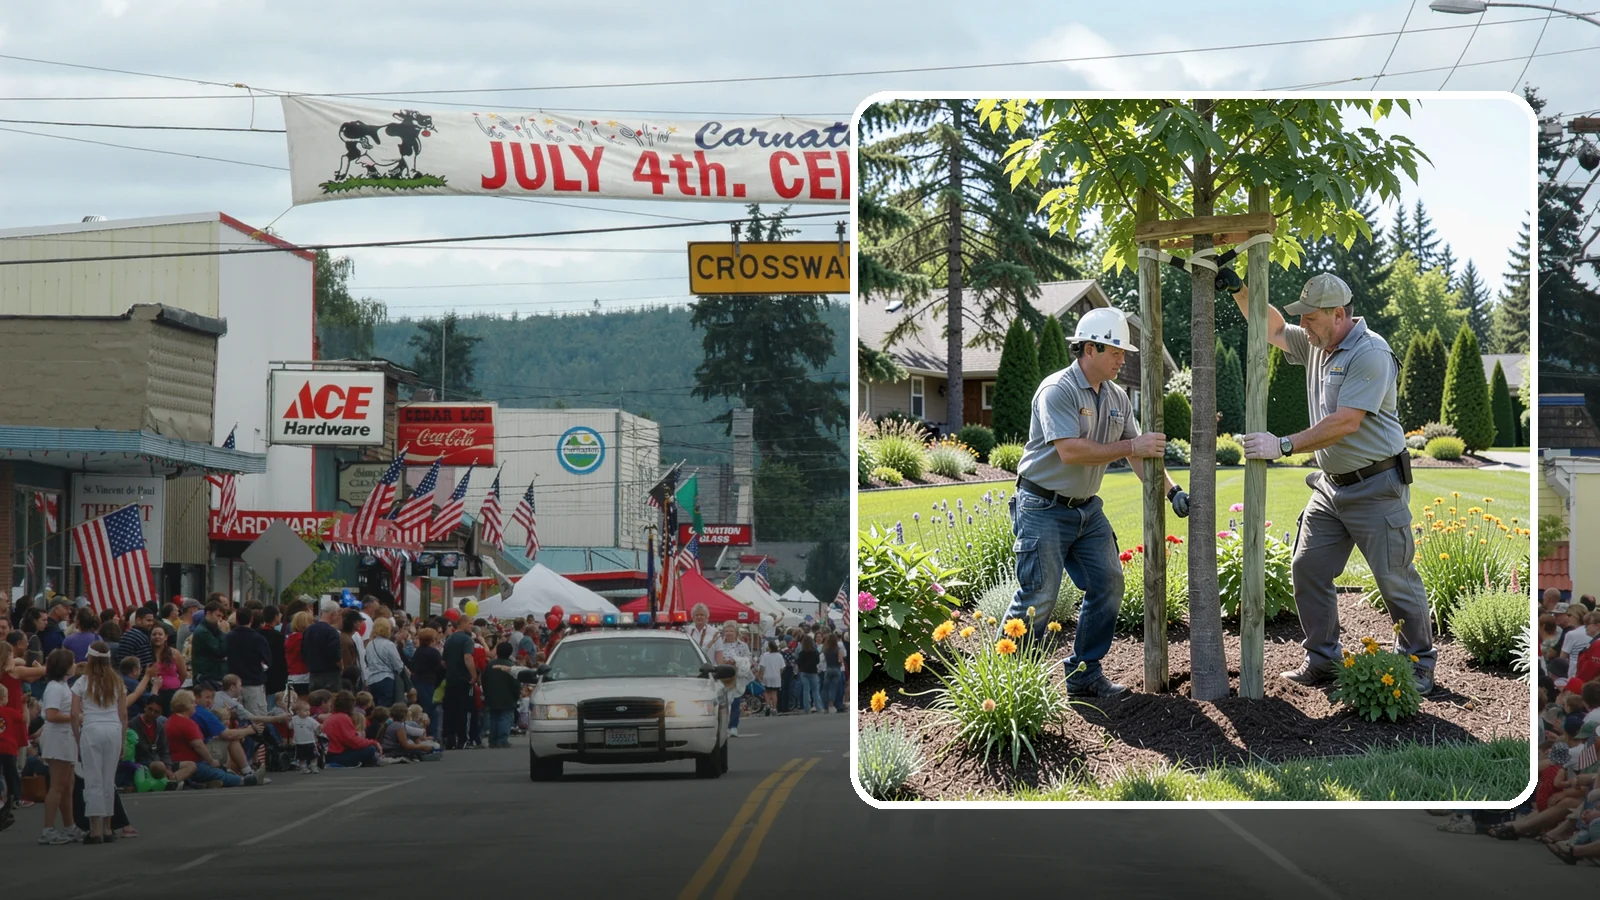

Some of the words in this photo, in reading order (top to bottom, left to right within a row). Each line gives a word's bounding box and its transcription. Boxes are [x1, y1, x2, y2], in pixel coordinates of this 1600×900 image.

[481, 141, 605, 192] JULY
[632, 150, 746, 197] 4th.
[697, 254, 849, 280] CROSSWA
[283, 380, 373, 420] ACE
[405, 409, 452, 422] CEDAR
[283, 421, 370, 436] Hardware
[416, 428, 477, 447] Coca-Cola
[353, 467, 385, 480] Simpl
[95, 485, 124, 495] Vincent
[126, 486, 135, 495] de
[137, 486, 155, 495] Paul
[688, 526, 741, 535] CRNATION
[699, 535, 730, 543] GLASS
